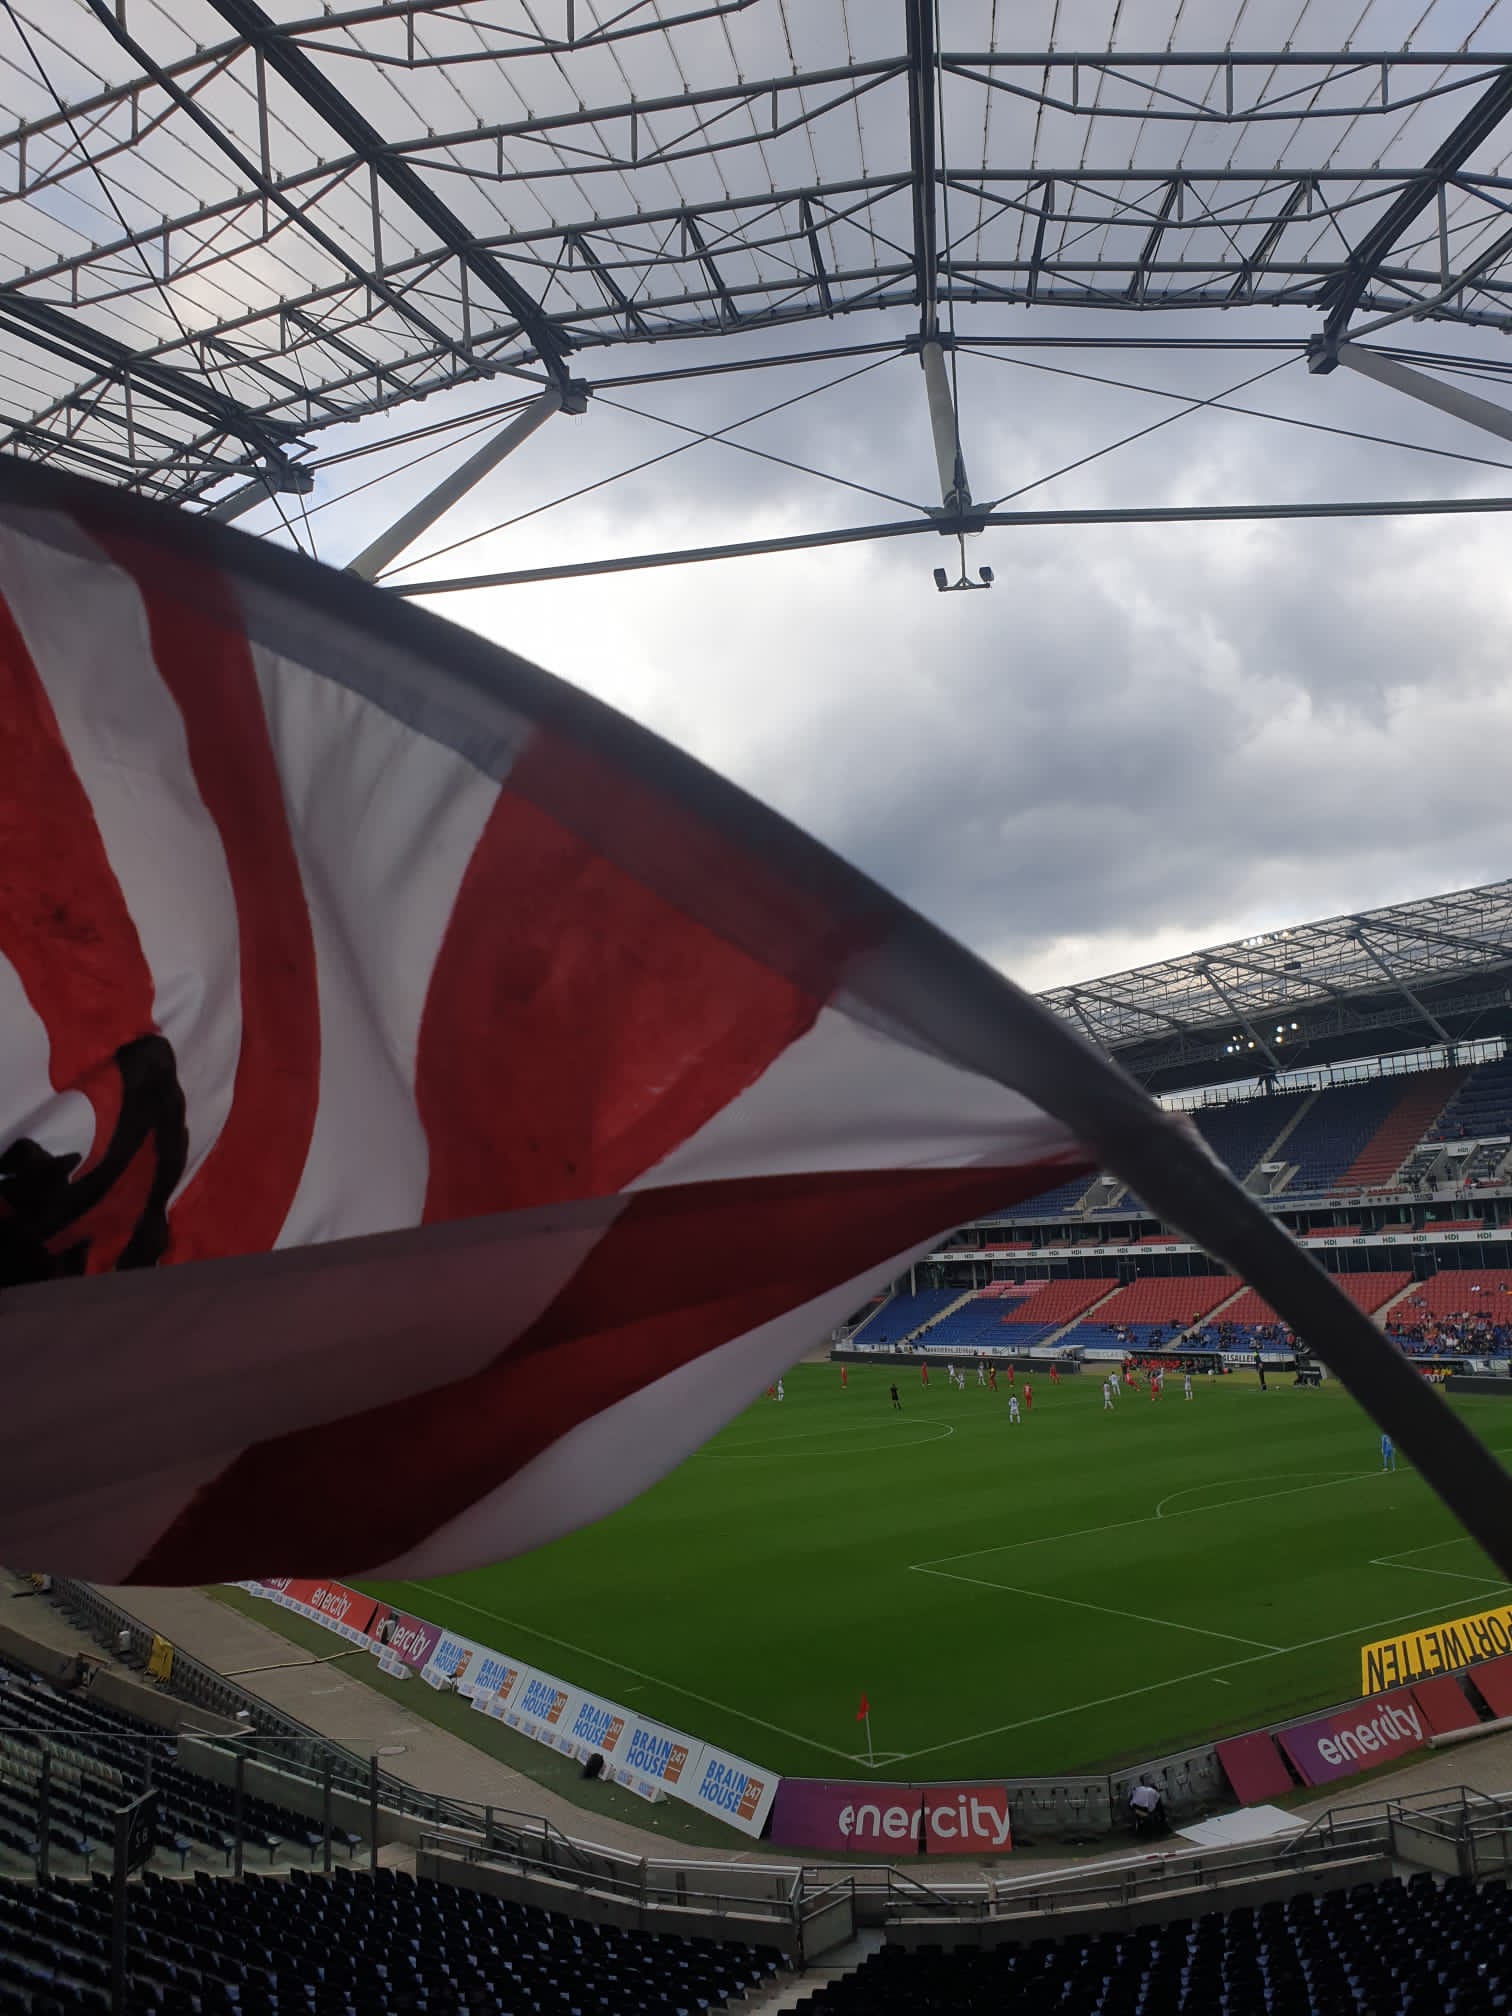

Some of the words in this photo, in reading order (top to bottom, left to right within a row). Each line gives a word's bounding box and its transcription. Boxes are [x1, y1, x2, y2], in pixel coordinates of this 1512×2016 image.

[1444, 1233, 1459, 1241] HDI
[311, 1587, 352, 1621] enercity
[440, 1640, 464, 1659] BRAIN
[527, 1679, 558, 1702] BRAIN
[521, 1695, 551, 1721] HOUSE
[579, 1703, 613, 1730] BRAIN
[572, 1718, 606, 1747] HOUSE
[632, 1728, 674, 1760] BRAIN
[626, 1746, 667, 1778] HOUSE
[670, 1750, 686, 1765] 247
[706, 1759, 749, 1794] BRAIN
[699, 1778, 743, 1814] HOUSE
[745, 1784, 762, 1801] 247
[838, 1794, 1011, 1845] enercity
